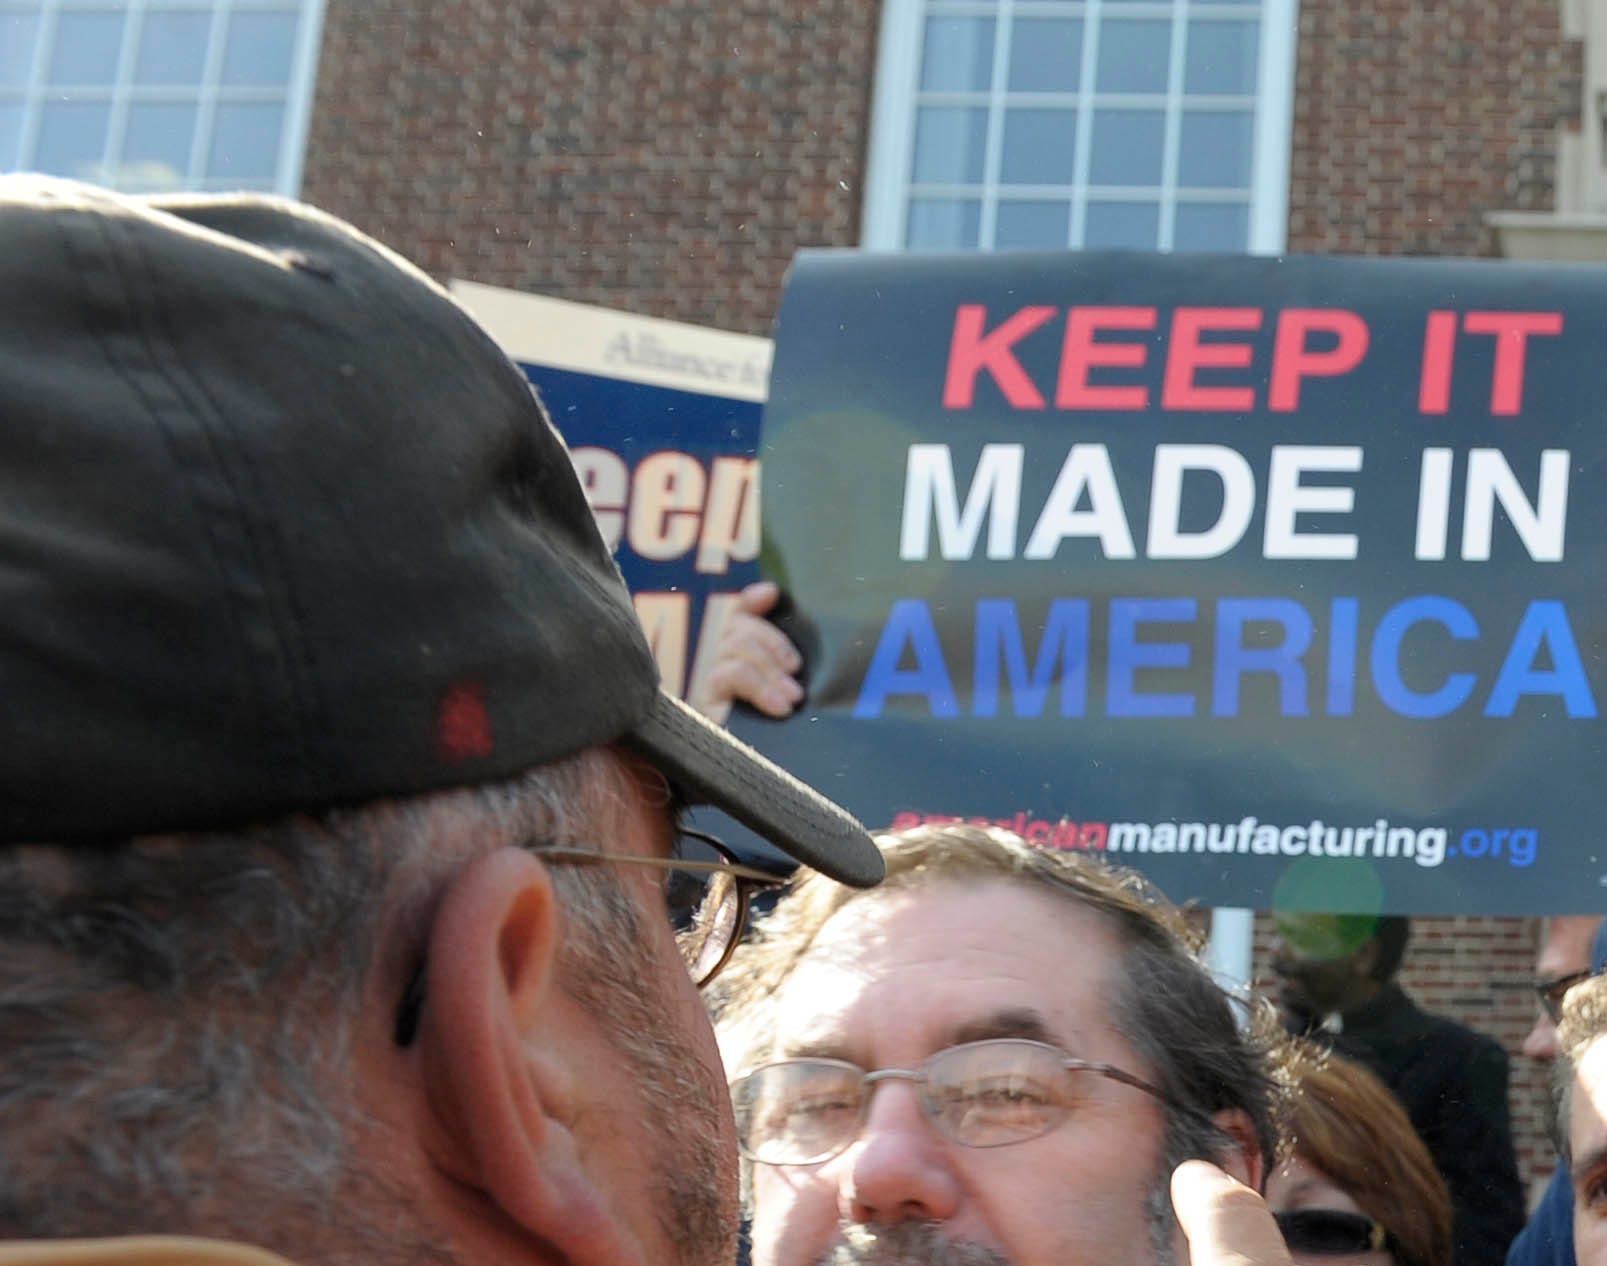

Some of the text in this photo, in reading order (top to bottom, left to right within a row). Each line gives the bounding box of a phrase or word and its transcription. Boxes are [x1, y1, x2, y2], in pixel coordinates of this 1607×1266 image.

[943, 305, 1563, 416] KEEP IT
[568, 446, 763, 575] eep
[899, 443, 1571, 562] MADE IN
[851, 594, 1601, 720] AMERICA
